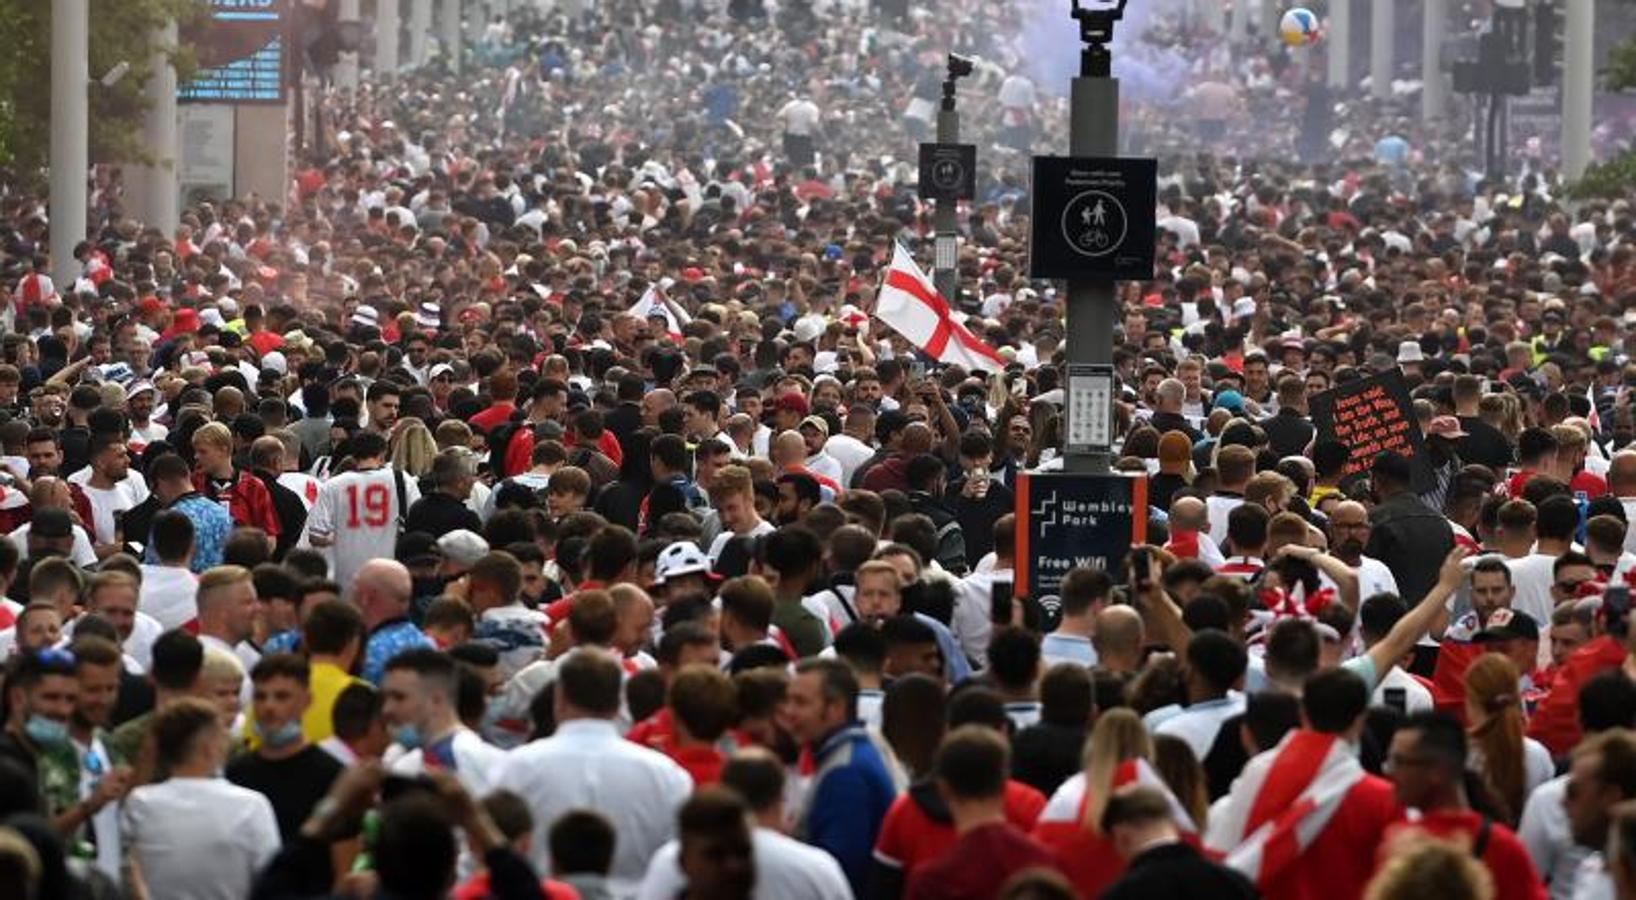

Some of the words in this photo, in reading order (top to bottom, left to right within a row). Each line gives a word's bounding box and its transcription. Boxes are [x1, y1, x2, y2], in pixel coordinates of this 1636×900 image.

[345, 484, 390, 529] 19
[1062, 514, 1097, 525] Park
[1038, 555, 1071, 569] Free
